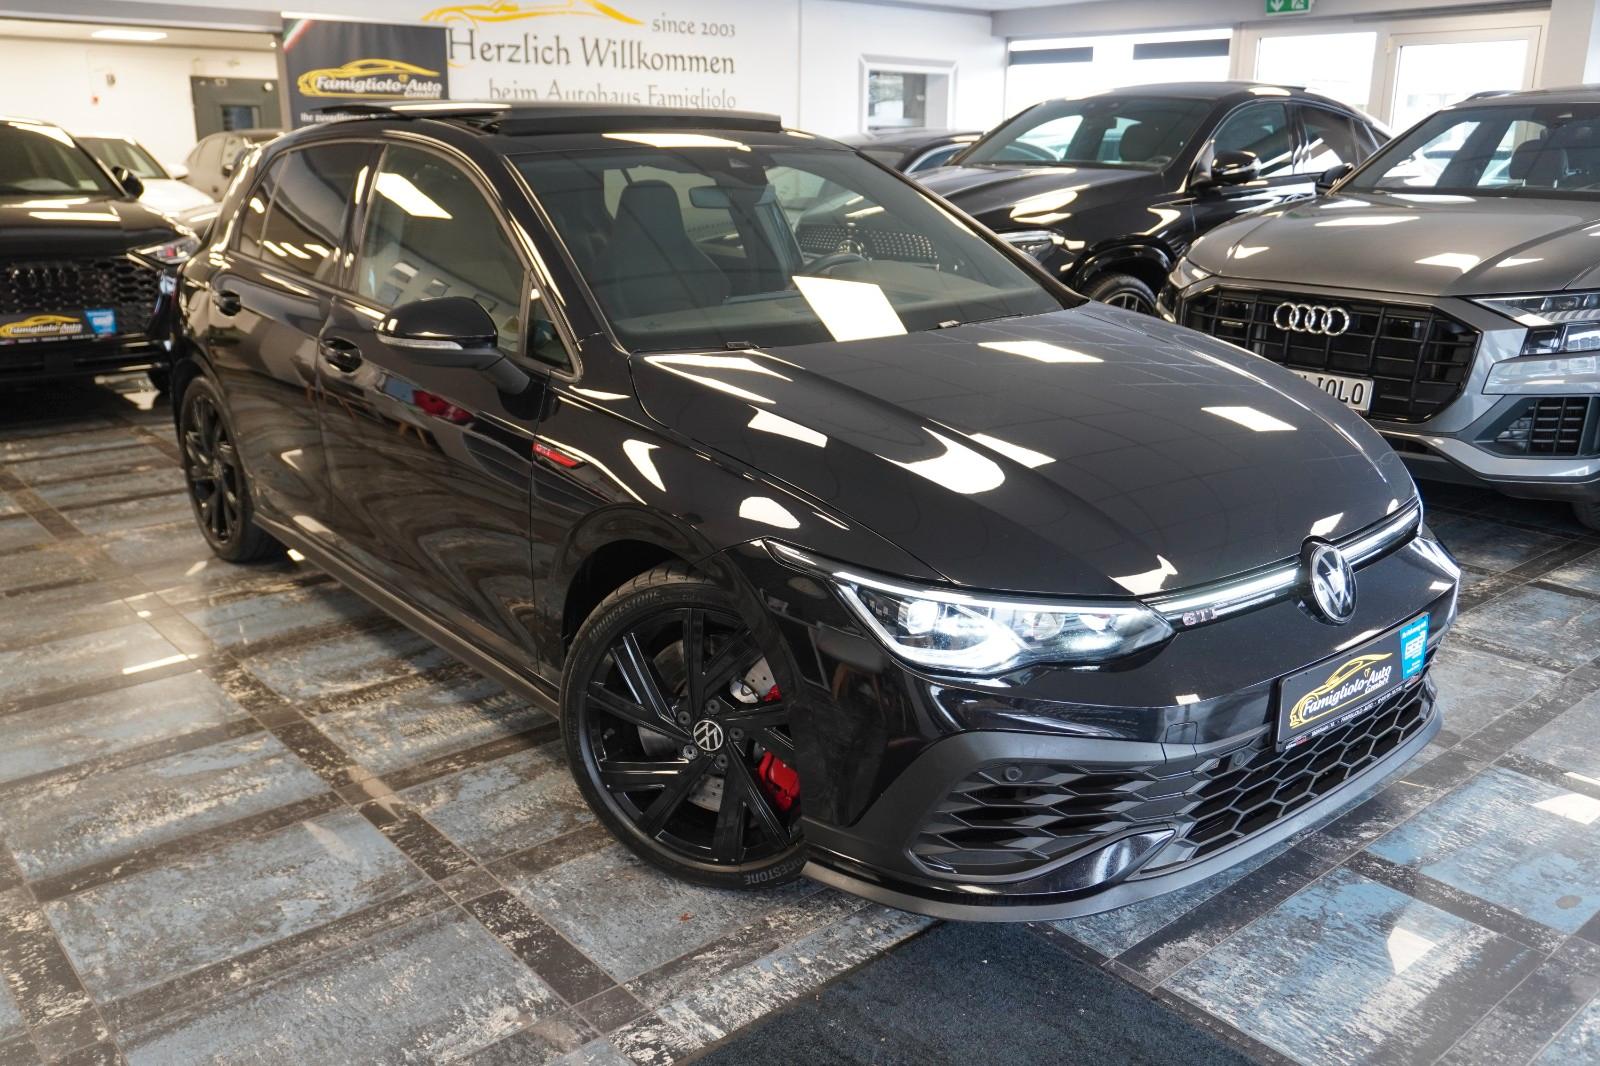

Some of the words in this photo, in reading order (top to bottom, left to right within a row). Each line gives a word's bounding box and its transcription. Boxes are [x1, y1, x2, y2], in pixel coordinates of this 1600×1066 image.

[651, 11, 696, 35] since
[701, 23, 735, 38] 2003
[448, 28, 571, 65] Herzlich
[580, 36, 735, 74] Willkommen
[316, 76, 443, 93] Famigliolo-Auto
[648, 84, 736, 109] Famigliolo
[1182, 607, 1217, 627] GTI
[1302, 665, 1392, 717] Famigliolo-Auto
